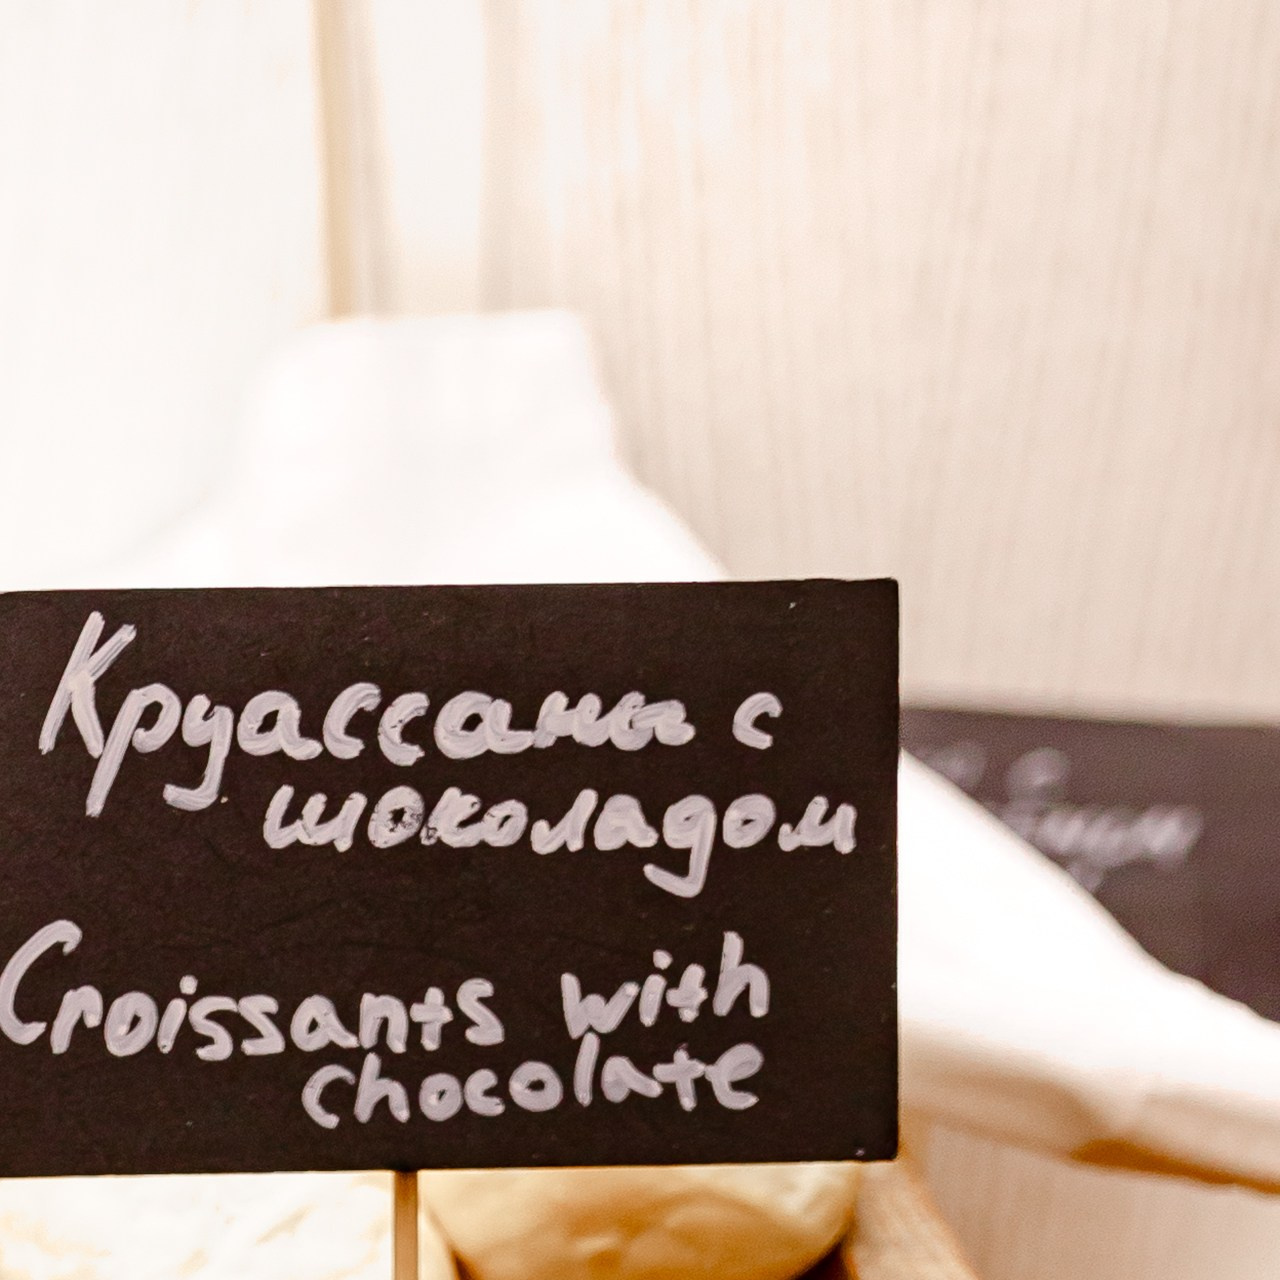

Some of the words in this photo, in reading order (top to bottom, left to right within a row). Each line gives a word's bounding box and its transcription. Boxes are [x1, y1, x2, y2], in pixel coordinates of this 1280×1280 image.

[731, 692, 783, 750] с
[262, 784, 857, 898] шоколадом
[560, 931, 770, 1039] with
[300, 1031, 764, 1129] chocolate
